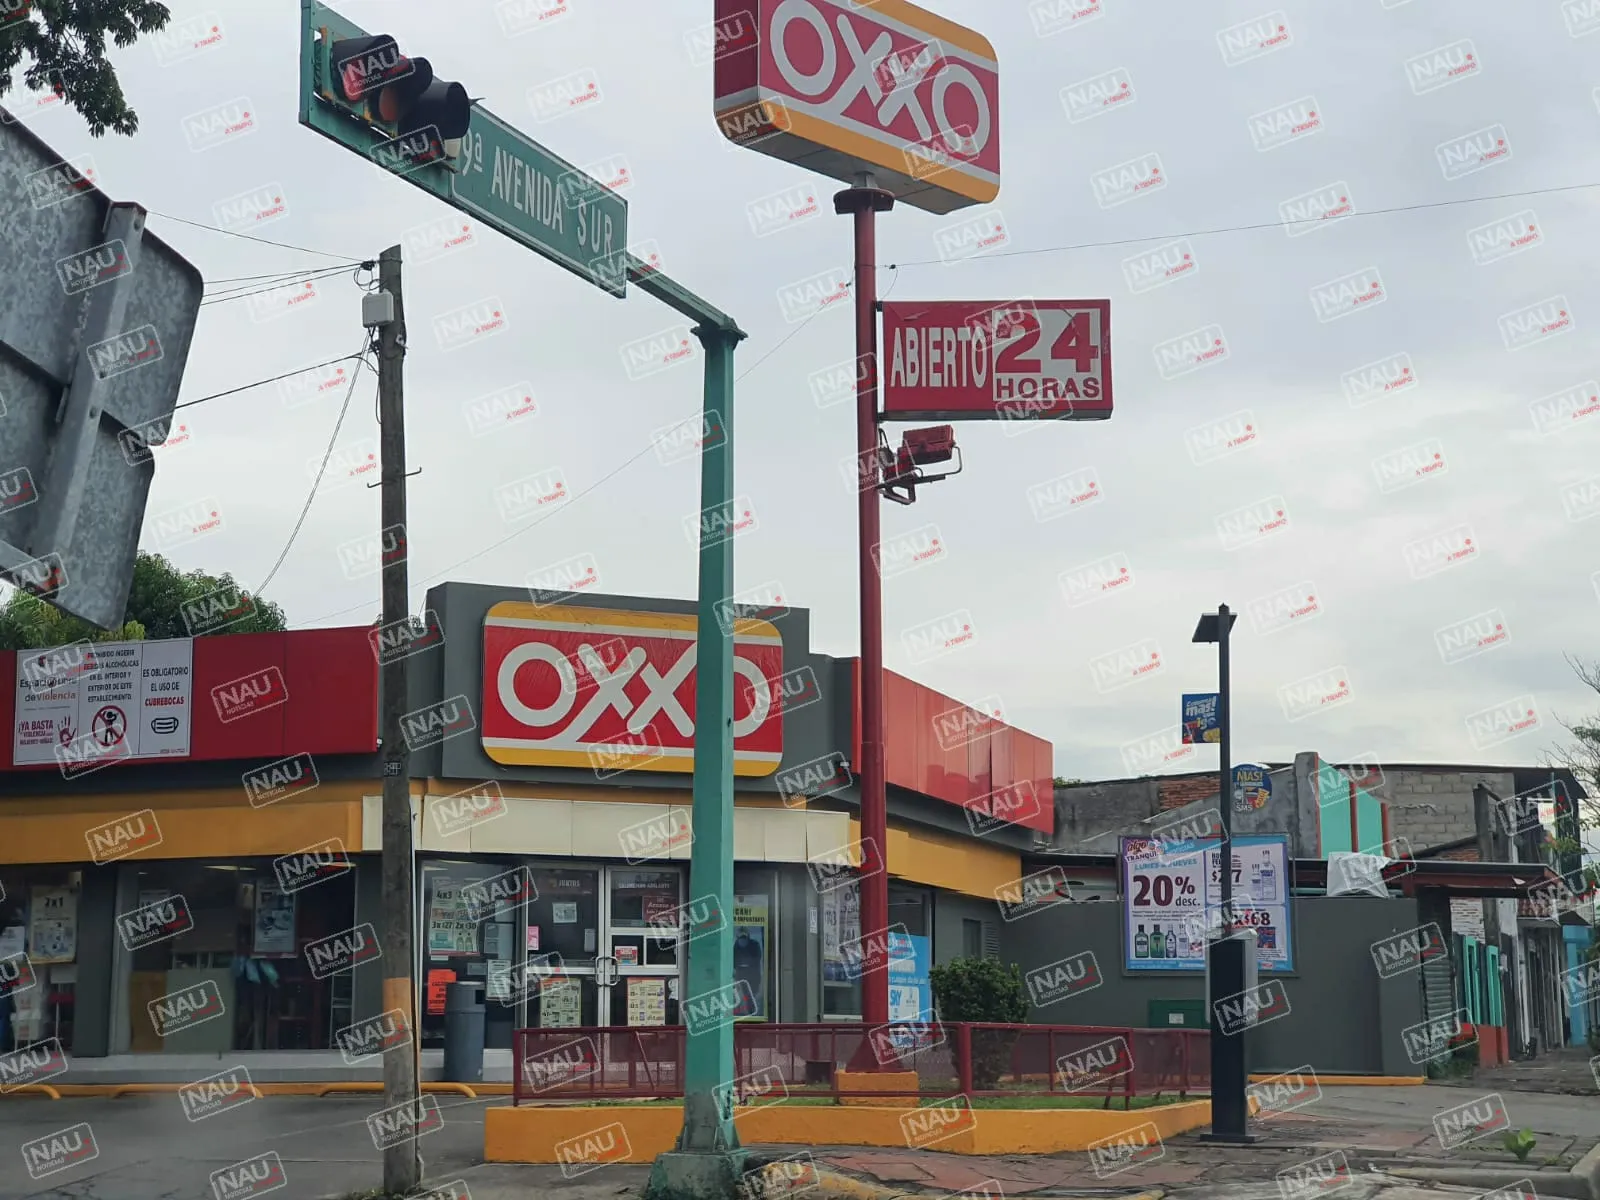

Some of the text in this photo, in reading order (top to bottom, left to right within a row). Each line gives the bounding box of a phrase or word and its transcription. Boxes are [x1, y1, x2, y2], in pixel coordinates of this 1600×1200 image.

[770, 0, 990, 156] OXXO
[491, 145, 563, 234] AVENIDA
[577, 198, 613, 270] SUR
[890, 310, 1099, 388] ABIERTO 24
[996, 377, 1100, 399] HORAS
[143, 667, 188, 677] ES OBLIGATORIO
[151, 681, 180, 691] EL USO DE
[144, 696, 184, 706] CUBREBOCAS
[1133, 874, 1195, 907] 20%
[1175, 895, 1201, 907] desc.
